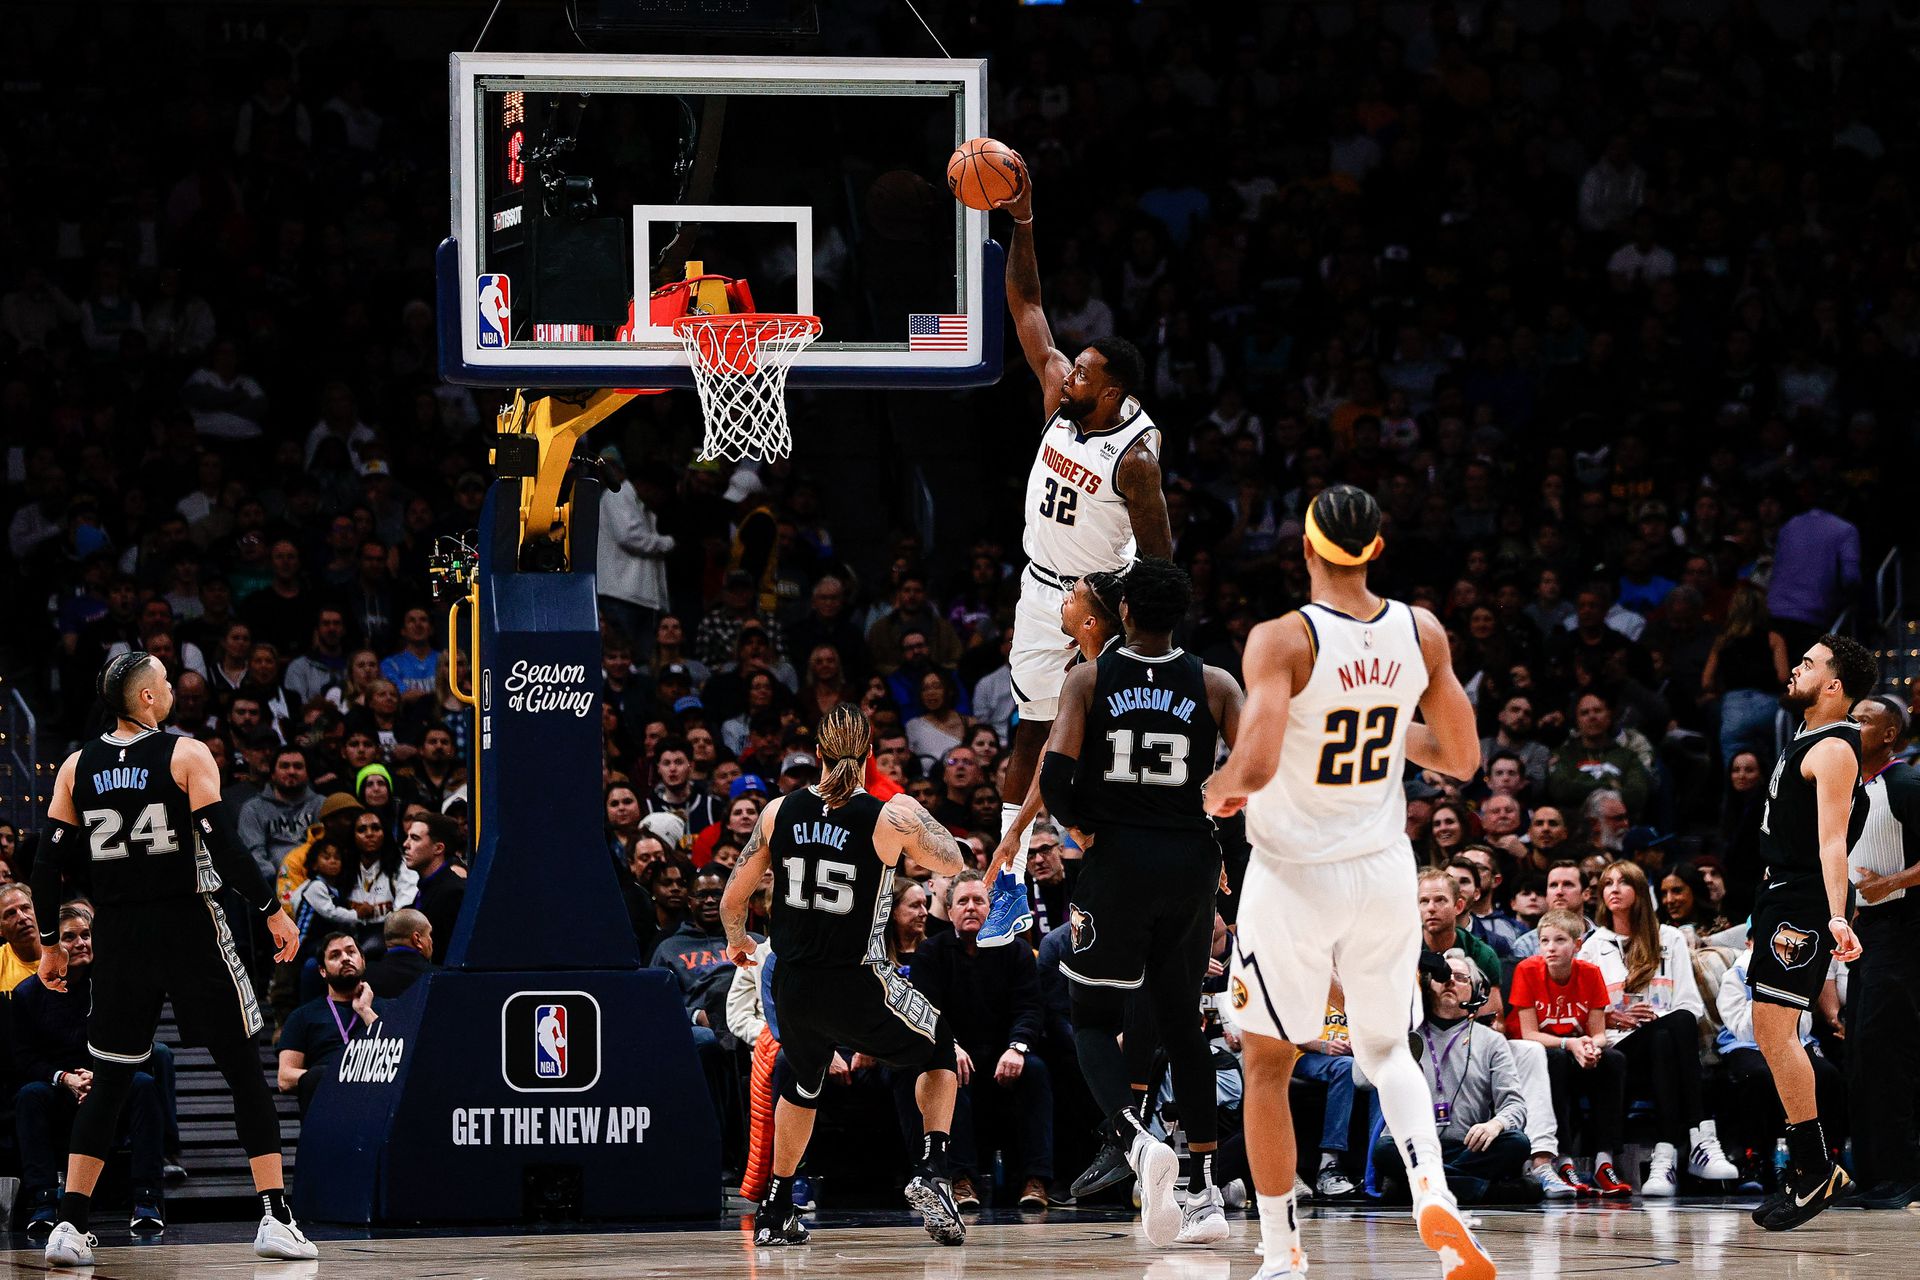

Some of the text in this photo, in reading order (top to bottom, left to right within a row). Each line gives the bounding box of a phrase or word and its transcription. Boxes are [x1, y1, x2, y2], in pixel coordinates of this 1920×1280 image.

[482, 332, 498, 345] NBA
[1103, 441, 1119, 455] WU
[1042, 443, 1102, 495] NUGGETS
[1039, 477, 1078, 526] 32
[504, 659, 586, 692] Season
[1337, 657, 1402, 692] NNAJI
[508, 684, 595, 718] of Giving
[1106, 686, 1197, 724] JACKSON JR.
[1103, 728, 1191, 787] 13
[1316, 704, 1399, 784] 22
[92, 766, 150, 796] BROOKS
[82, 802, 180, 862] 24
[792, 820, 851, 851] CLARKE
[781, 855, 858, 916] 15
[338, 1020, 405, 1084] coinbase
[539, 1060, 557, 1075] NBA
[452, 1105, 651, 1146] GET THE NEW APP
